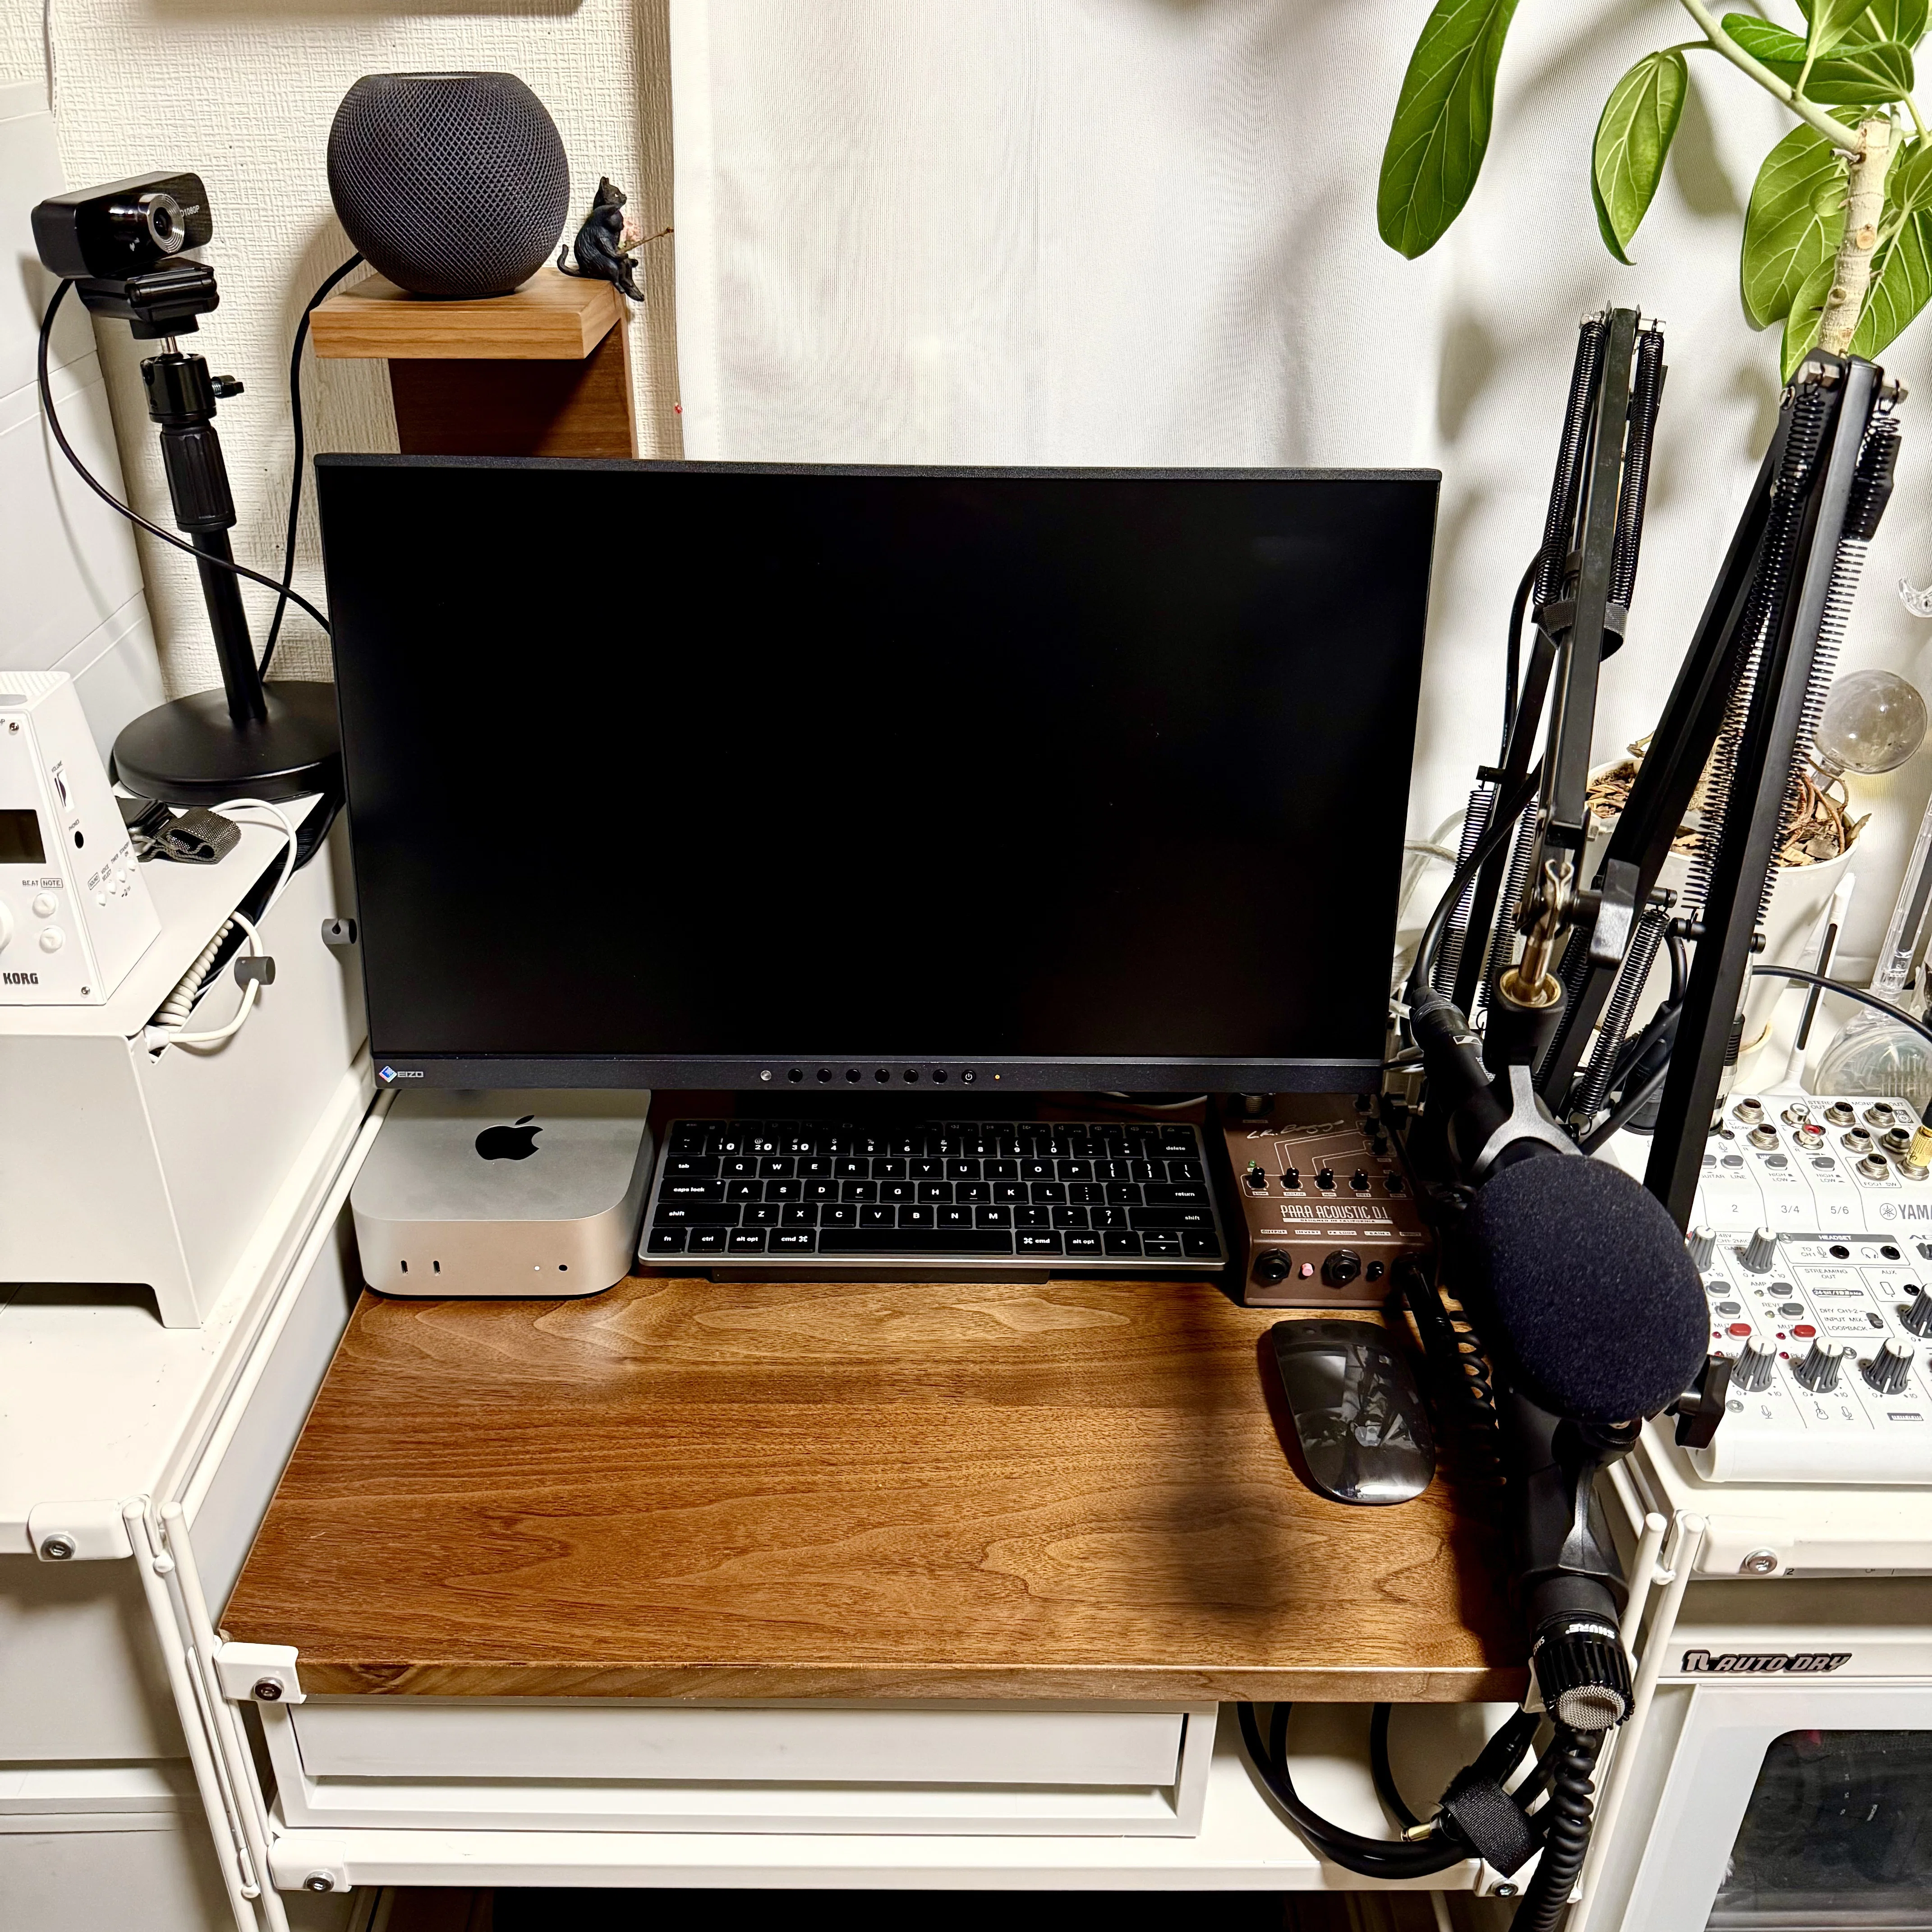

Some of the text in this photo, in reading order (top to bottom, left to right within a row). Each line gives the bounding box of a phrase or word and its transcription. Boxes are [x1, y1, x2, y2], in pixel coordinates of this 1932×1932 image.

[179, 205, 200, 218] D1080P
[3, 972, 39, 984] KORG
[1280, 1205, 1313, 1218] PARA
[1316, 1205, 1371, 1219] ACOUSTIC
[1732, 1205, 1849, 1214] 2 3/4 5/6
[1898, 1204, 1932, 1220] YAM
[1569, 1623, 1615, 1639] SHURE
[1714, 1656, 1788, 1671] AUTO
[1789, 1656, 1850, 1671] DRY
